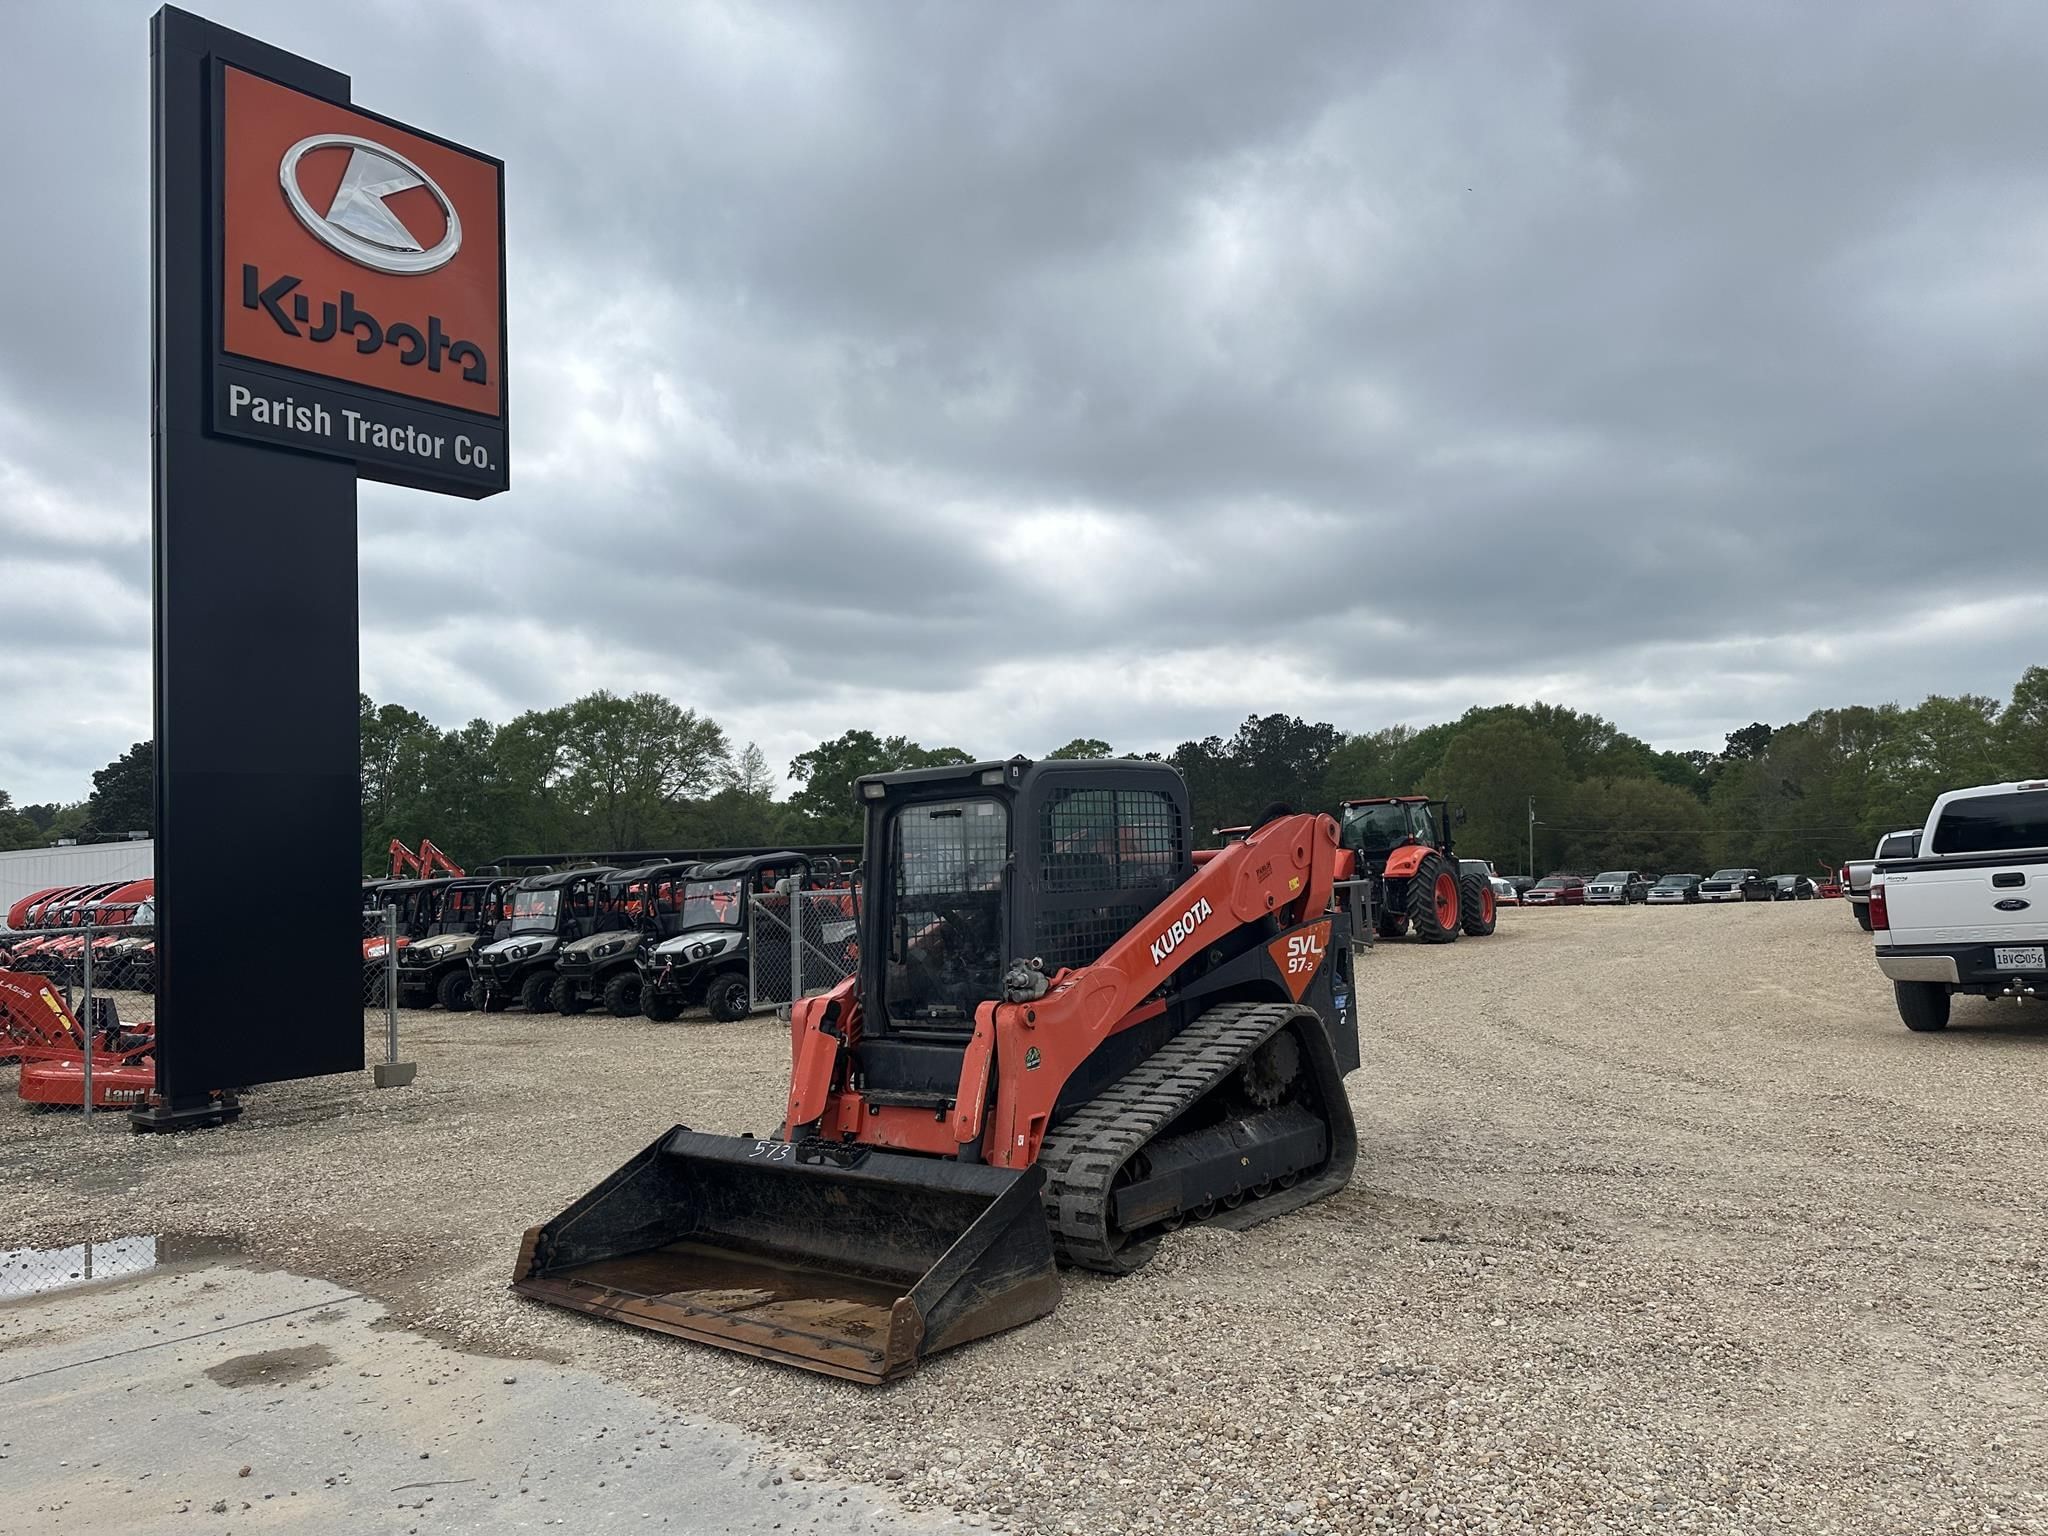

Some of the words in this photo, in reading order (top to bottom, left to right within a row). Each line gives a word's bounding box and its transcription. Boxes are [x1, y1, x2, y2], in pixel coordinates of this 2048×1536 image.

[242, 263, 487, 386] Kubota
[229, 384, 331, 436] Parish
[341, 409, 445, 460] Tractor
[454, 434, 496, 471] Co.
[1149, 897, 1214, 966] KUBOTA
[1287, 935, 1324, 957] SVL
[1287, 957, 1313, 974] 97-2
[748, 1140, 791, 1161] 573
